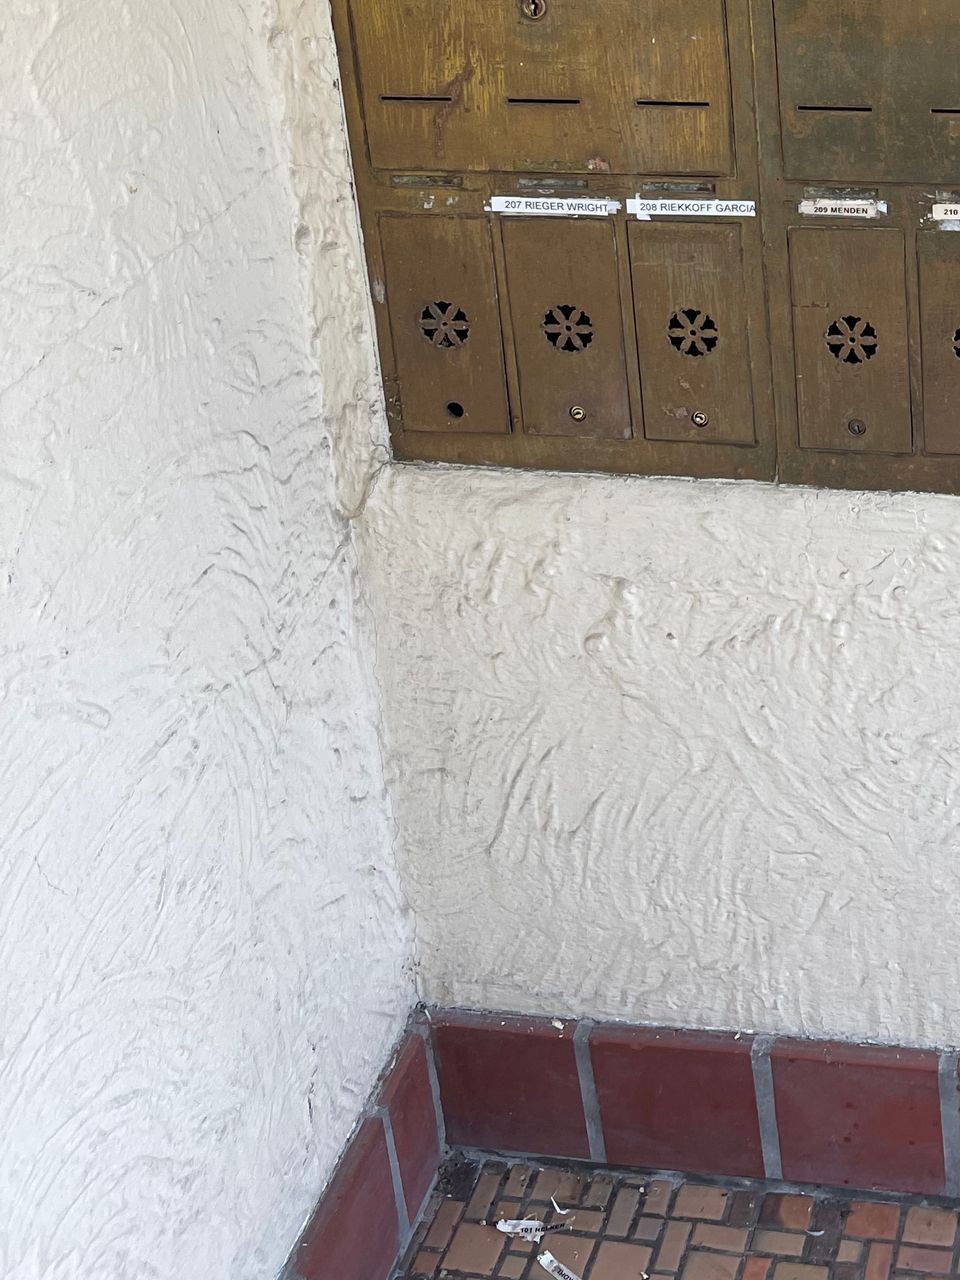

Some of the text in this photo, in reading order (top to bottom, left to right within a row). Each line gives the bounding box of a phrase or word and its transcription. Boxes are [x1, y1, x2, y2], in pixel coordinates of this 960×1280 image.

[505, 200, 608, 213] 207 RIEGER WRIGHT
[640, 202, 756, 214] 208 RIEKKOFF GARCIA
[814, 206, 868, 215] 209 MENDEN
[943, 208, 958, 216] 210
